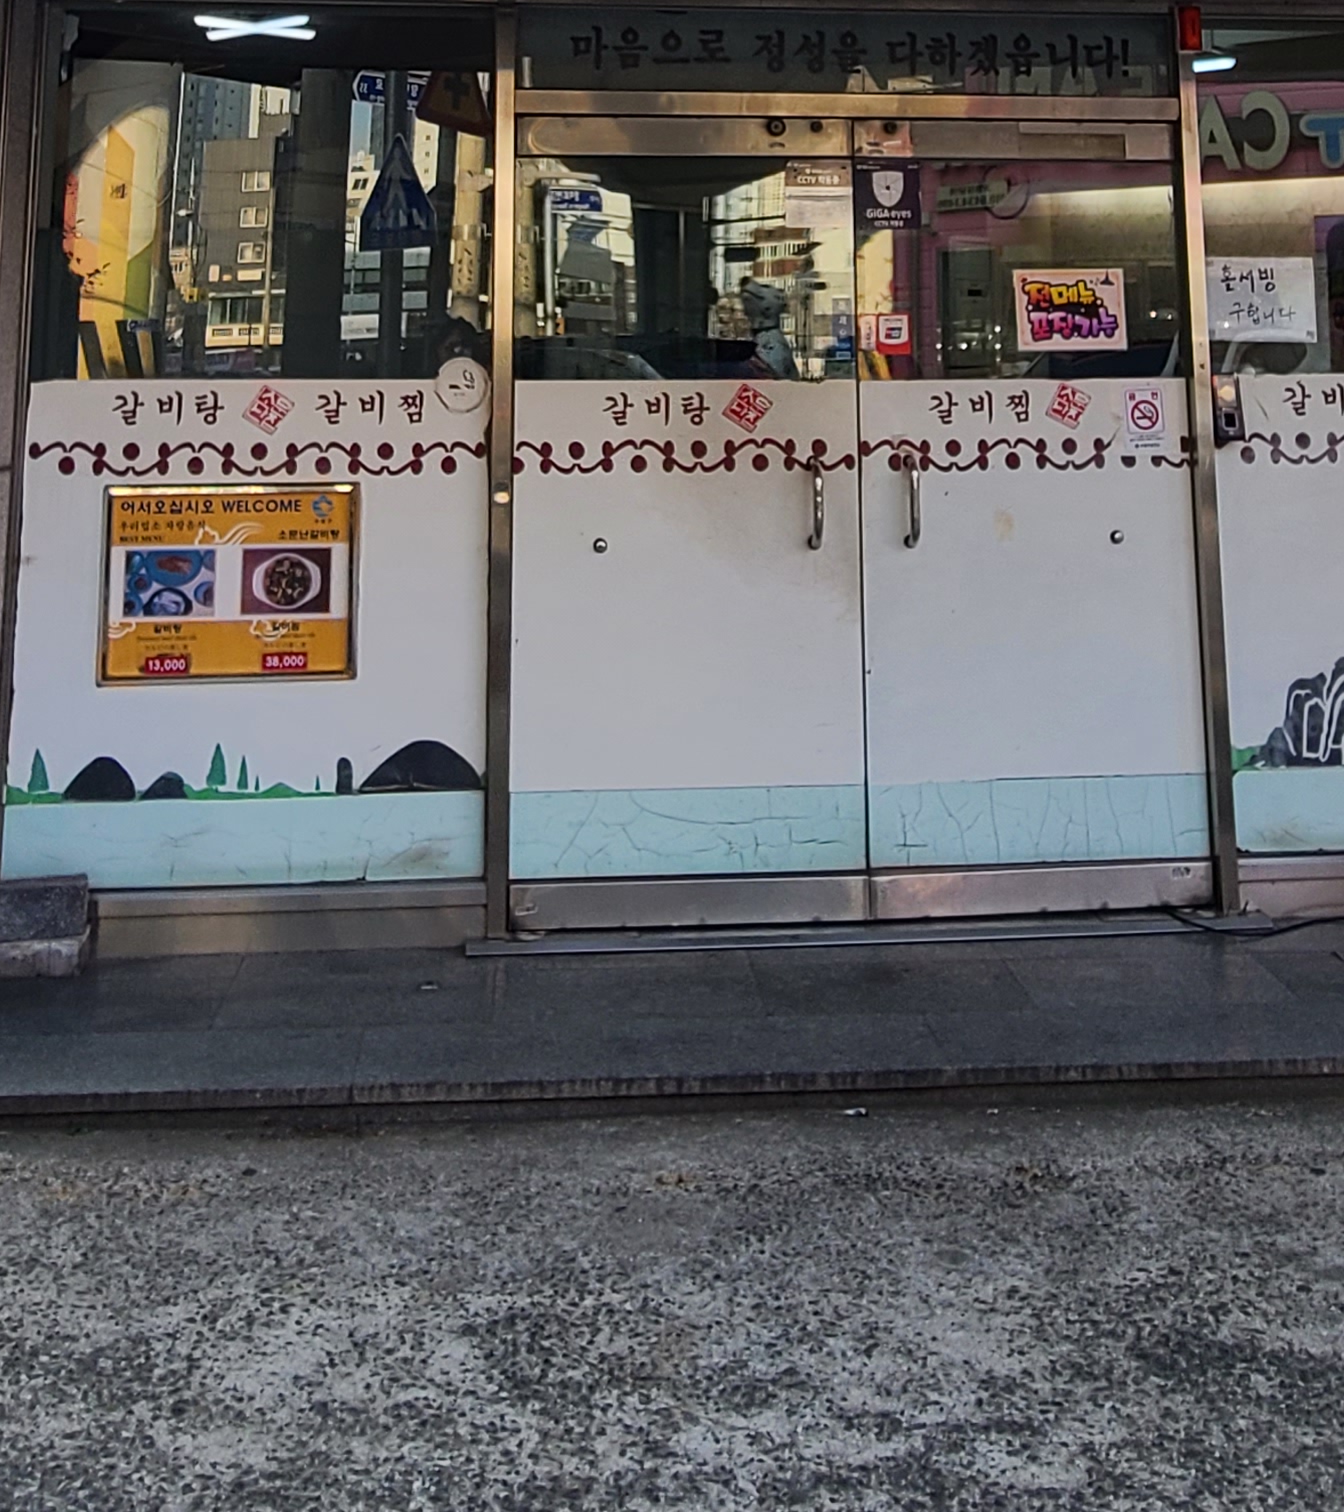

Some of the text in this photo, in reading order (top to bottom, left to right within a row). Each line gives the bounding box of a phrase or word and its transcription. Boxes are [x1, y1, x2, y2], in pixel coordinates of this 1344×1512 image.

[570, 25, 731, 70] 마음으로
[752, 29, 867, 75] 정성을
[797, 175, 816, 185] CCTV
[112, 390, 225, 426] 갈비탕
[315, 390, 425, 425] 갈비찜
[602, 391, 711, 427] 갈비탕
[929, 390, 1031, 425] 갈비찜
[120, 499, 302, 516] 어서오십시오 WELCOME
[148, 659, 186, 671] 13,000
[265, 655, 304, 668] 38,000
